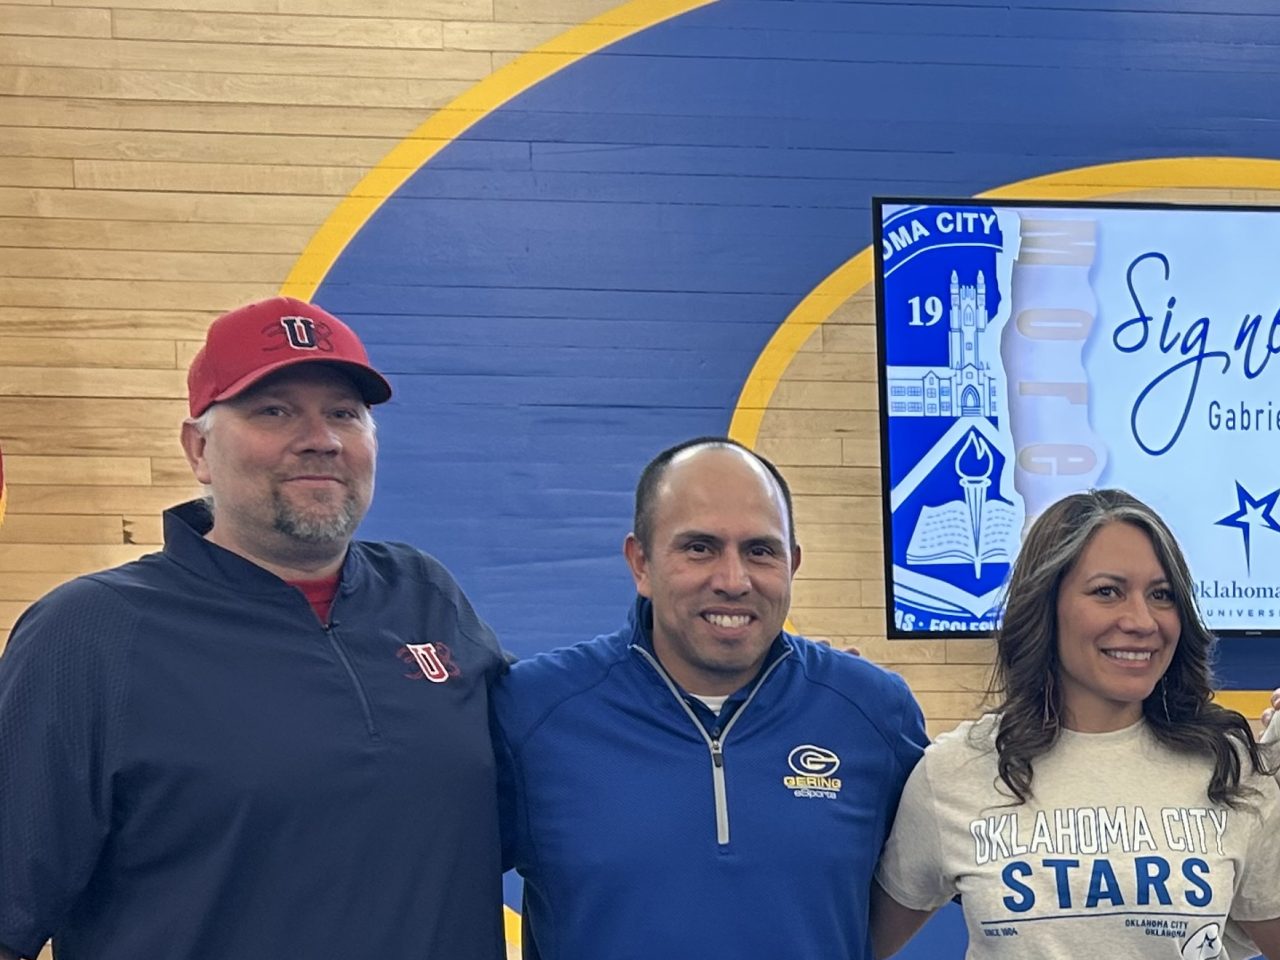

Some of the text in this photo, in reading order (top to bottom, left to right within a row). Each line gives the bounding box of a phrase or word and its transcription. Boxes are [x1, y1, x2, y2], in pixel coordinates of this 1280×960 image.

[936, 211, 996, 234] CITY
[907, 296, 943, 326] 19
[1016, 220, 1097, 541] More
[783, 776, 842, 789] GERING
[970, 806, 1228, 865] OKLAHOMA CITY
[1001, 856, 1213, 913] STARS
[1125, 919, 1189, 930] OKLAHOMA CITY
[1145, 929, 1186, 938] OKLAHOMA
